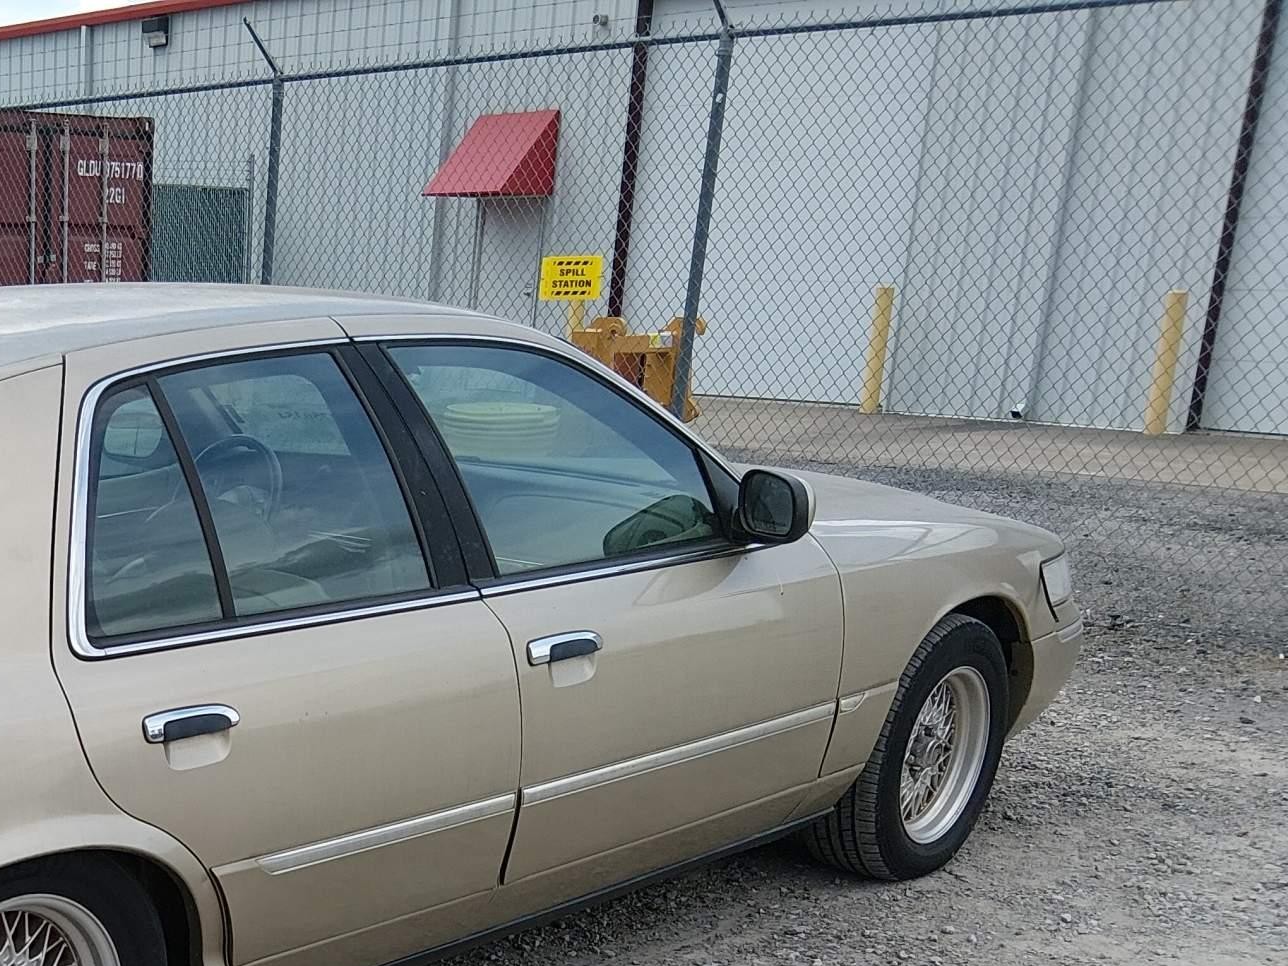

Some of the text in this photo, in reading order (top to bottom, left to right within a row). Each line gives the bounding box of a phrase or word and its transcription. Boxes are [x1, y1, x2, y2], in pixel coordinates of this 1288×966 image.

[77, 159, 101, 177] GLDU
[559, 268, 586, 277] SPILL
[551, 279, 592, 288] STATION
